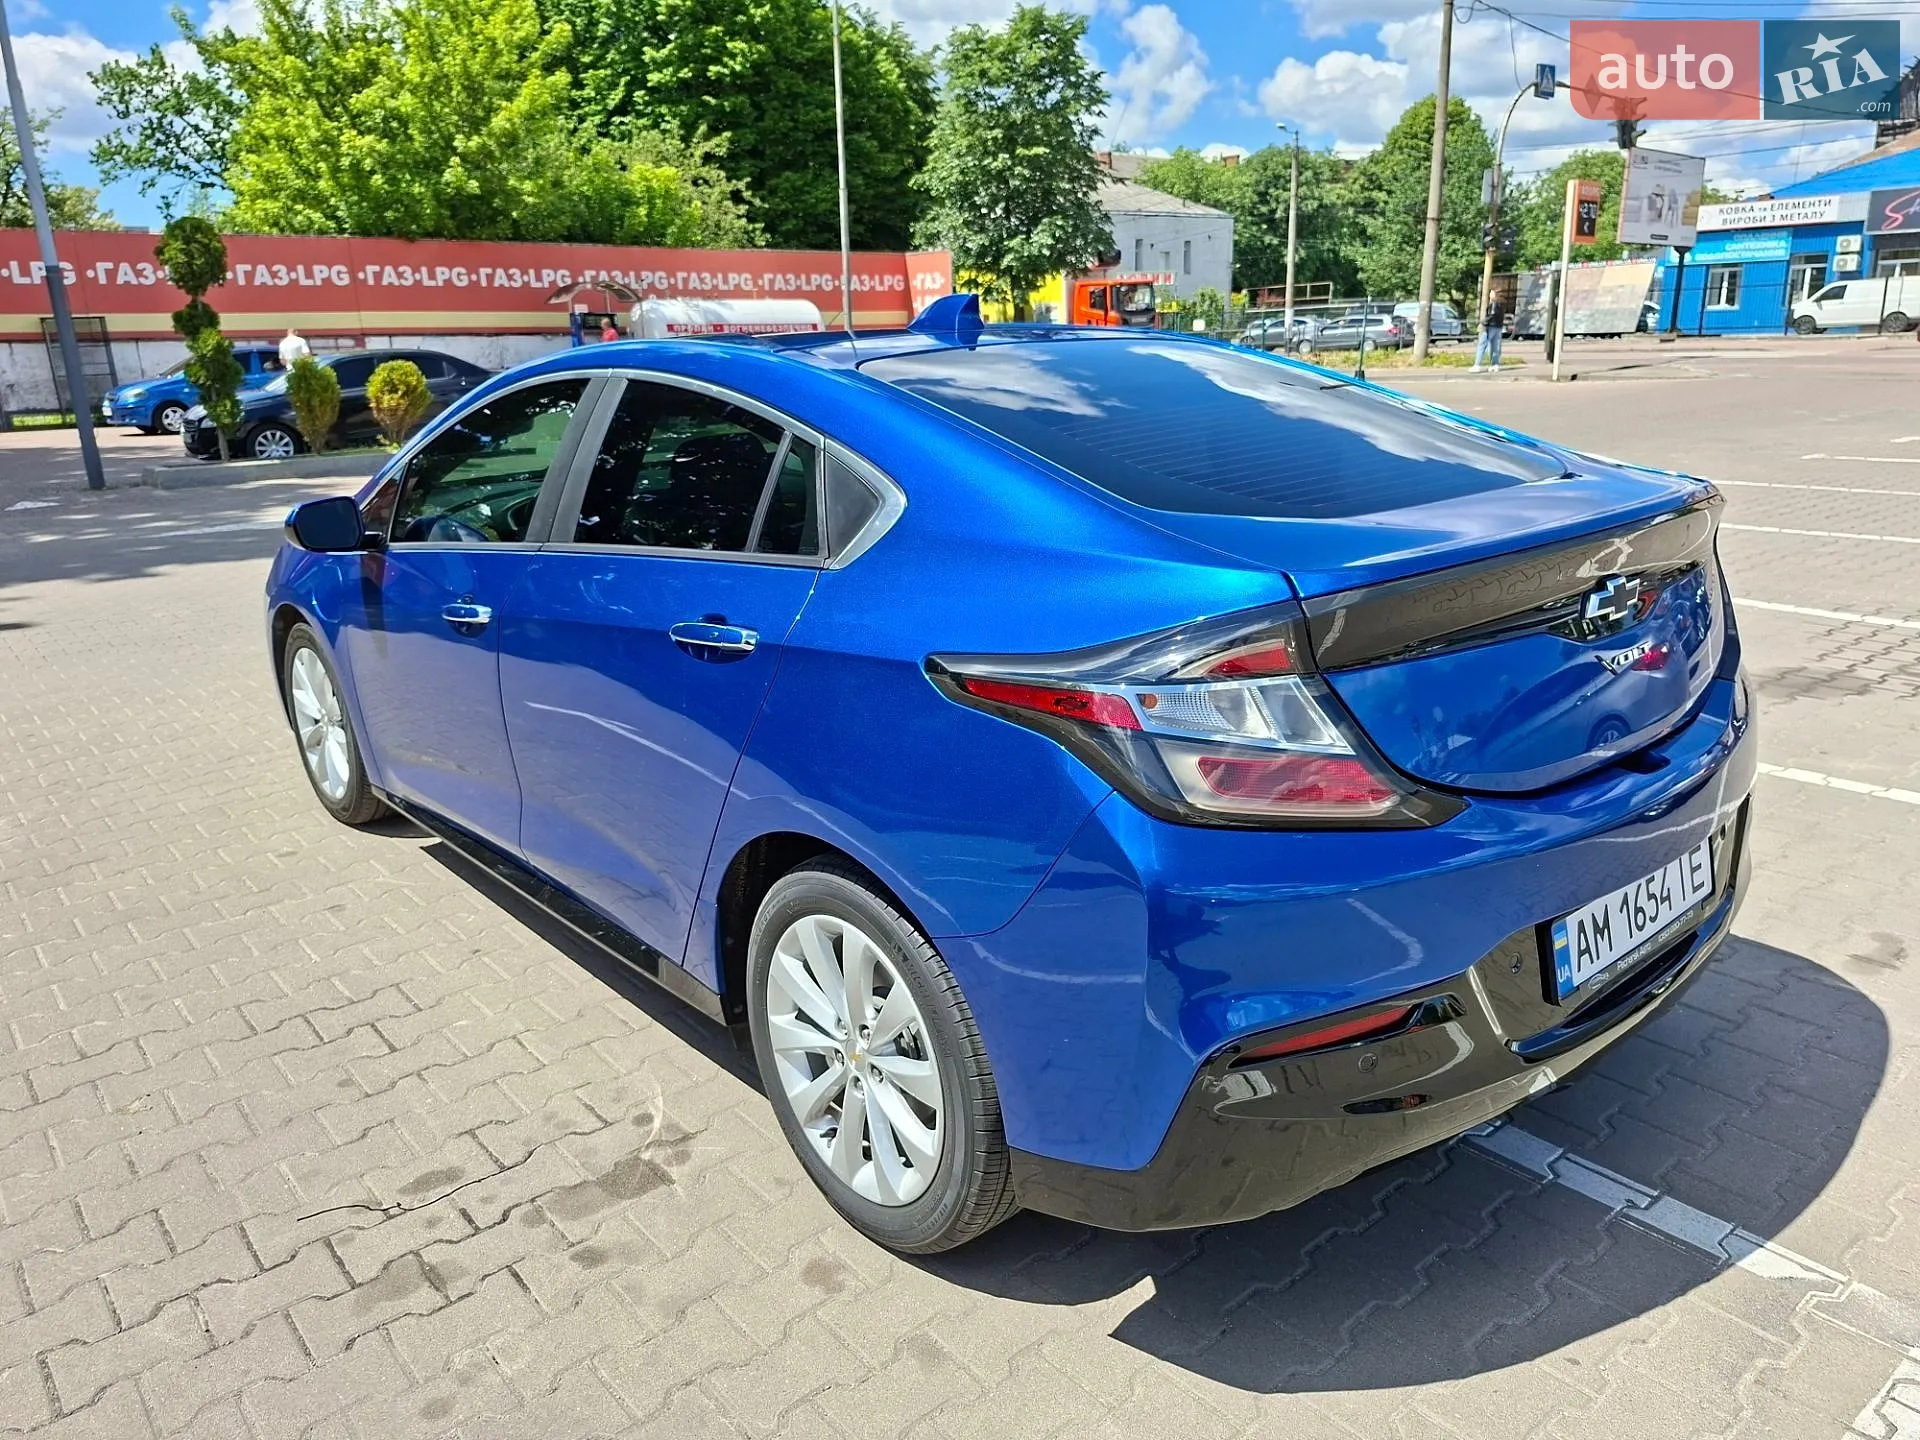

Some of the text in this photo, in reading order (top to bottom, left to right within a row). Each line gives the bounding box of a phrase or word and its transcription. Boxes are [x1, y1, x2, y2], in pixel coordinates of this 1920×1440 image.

[1718, 204, 1756, 216] КОВКА
[1770, 199, 1832, 212] ЕЛЕМЕНТИ
[1722, 214, 1767, 226] ВИРОБИ
[1778, 210, 1826, 223] МЕТАЛУ
[1576, 903, 1613, 974] AM
[1619, 866, 1673, 940] 1654
[1679, 848, 1705, 902] IE
[1557, 967, 1572, 983] UA
